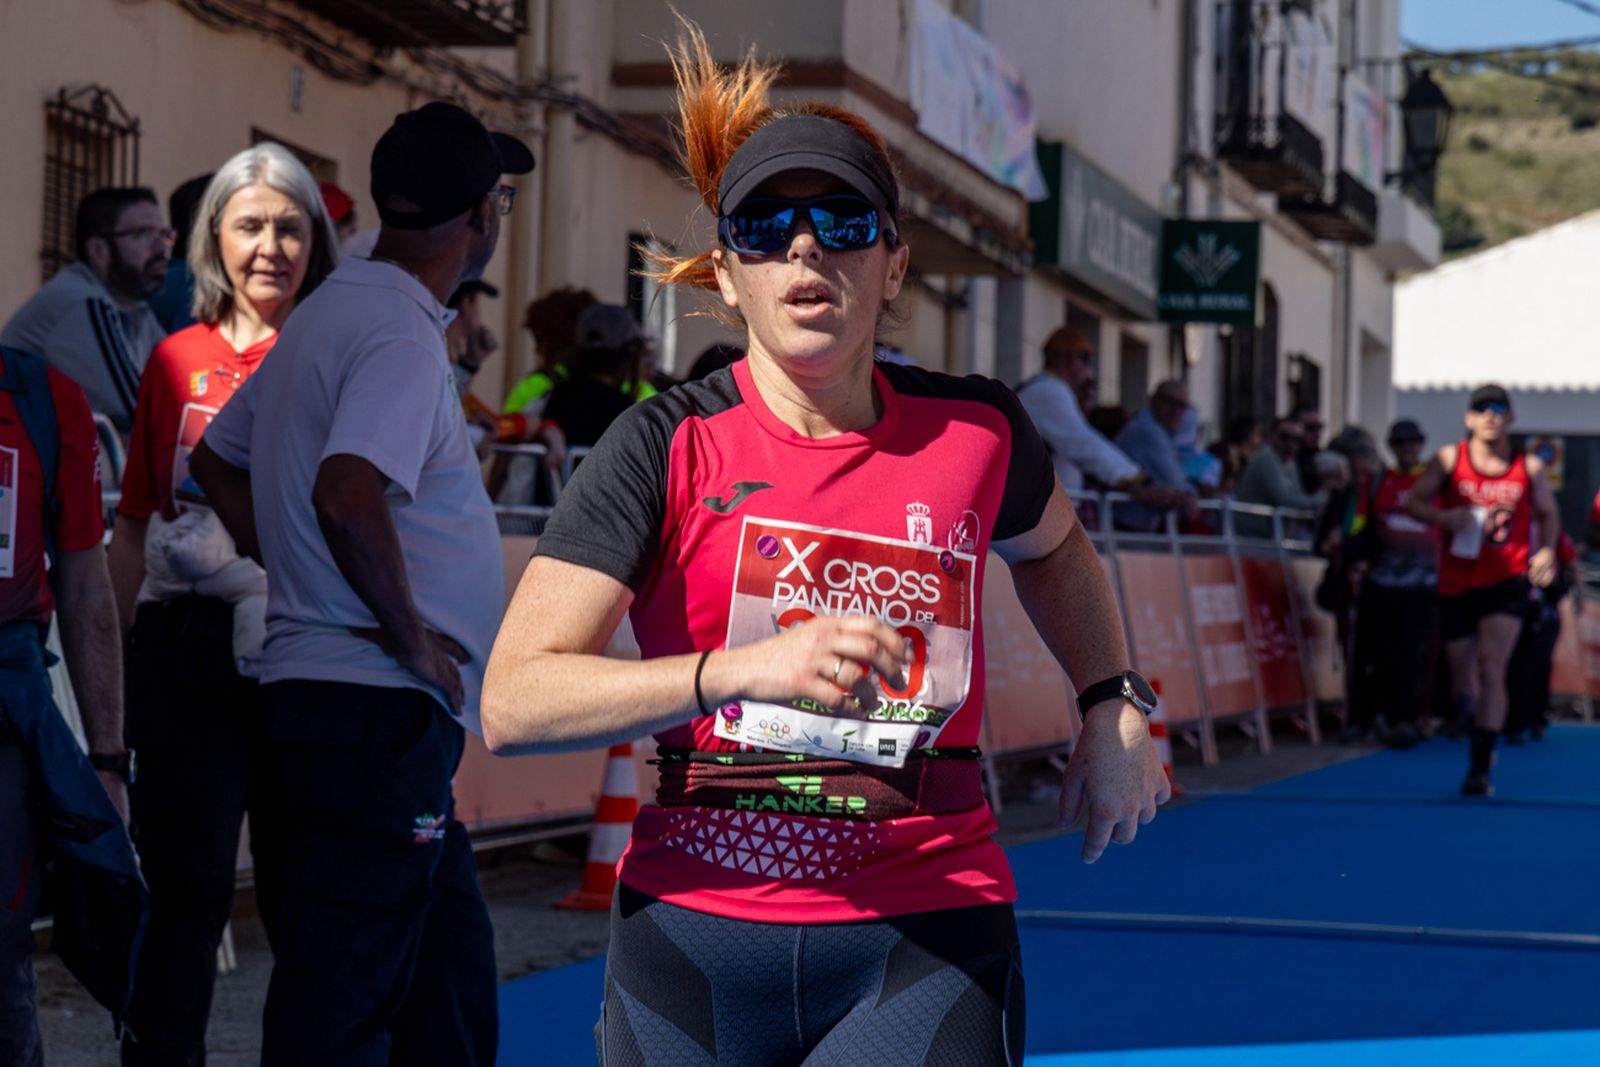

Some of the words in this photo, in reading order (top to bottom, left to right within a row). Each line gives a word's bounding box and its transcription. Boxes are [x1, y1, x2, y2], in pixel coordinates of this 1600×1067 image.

[776, 536, 820, 582] X
[823, 558, 941, 604] CROSS
[772, 581, 911, 627] PANTANO
[914, 610, 936, 624] DEL
[735, 794, 867, 814] HANKER
